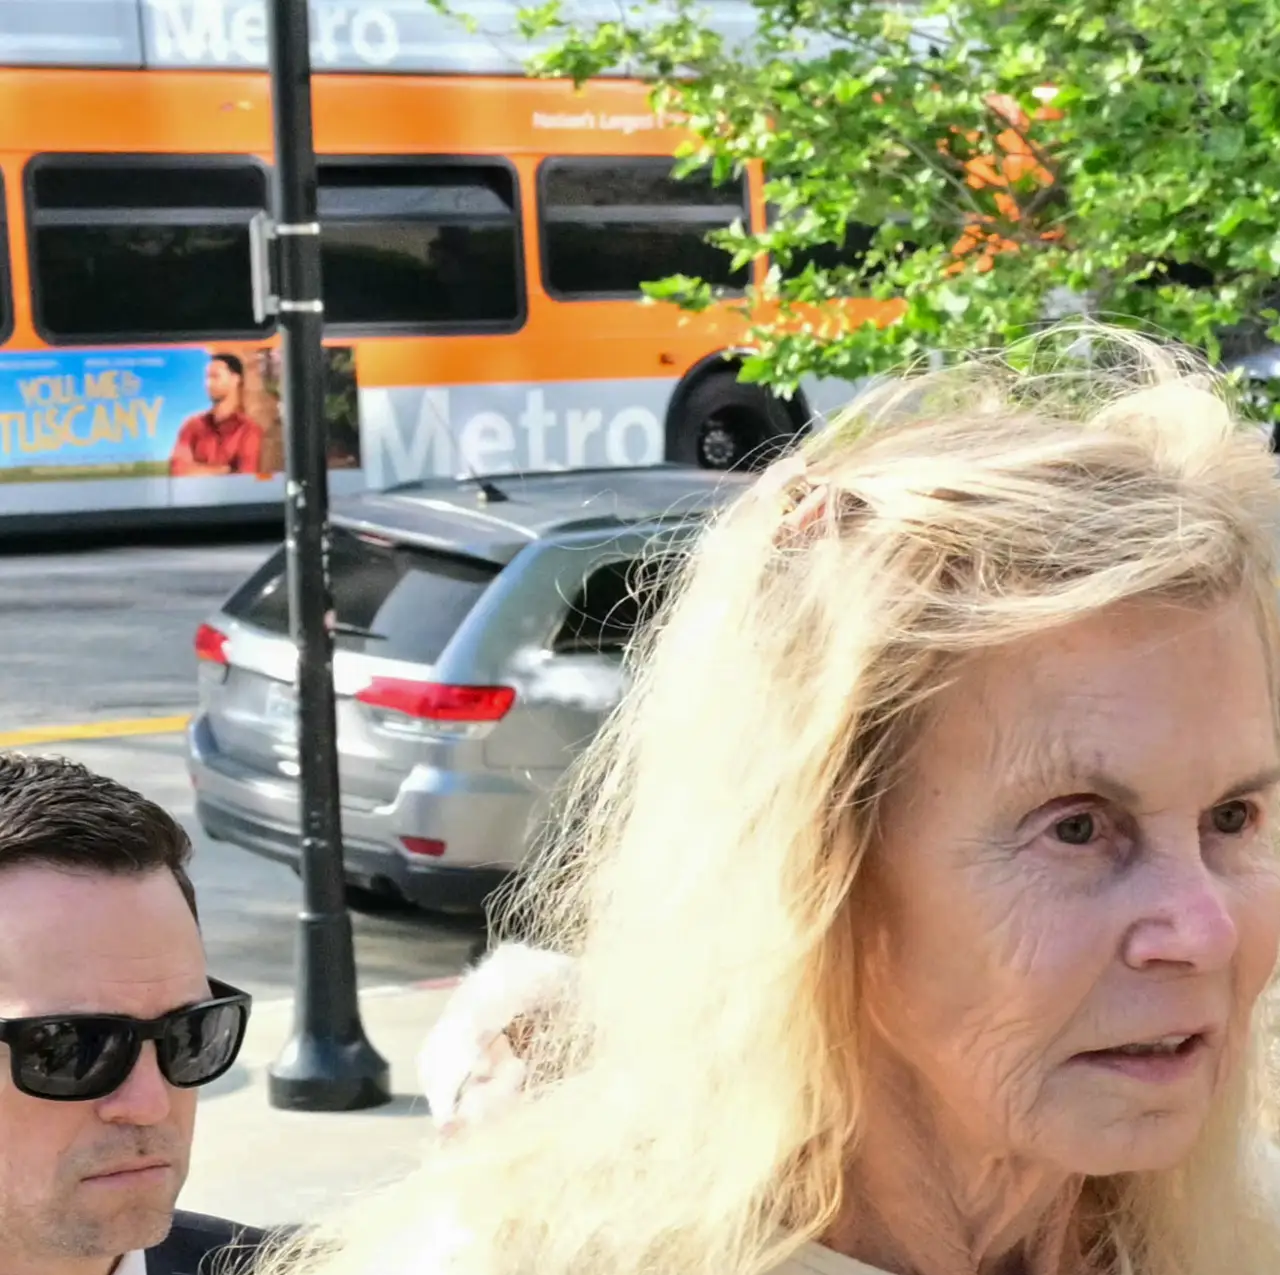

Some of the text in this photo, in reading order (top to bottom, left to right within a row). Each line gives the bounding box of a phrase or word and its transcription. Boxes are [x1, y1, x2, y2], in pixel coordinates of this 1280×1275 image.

[152, 0, 400, 65] Mero
[0, 396, 164, 454] TUSCANY
[359, 386, 663, 490] Metro
